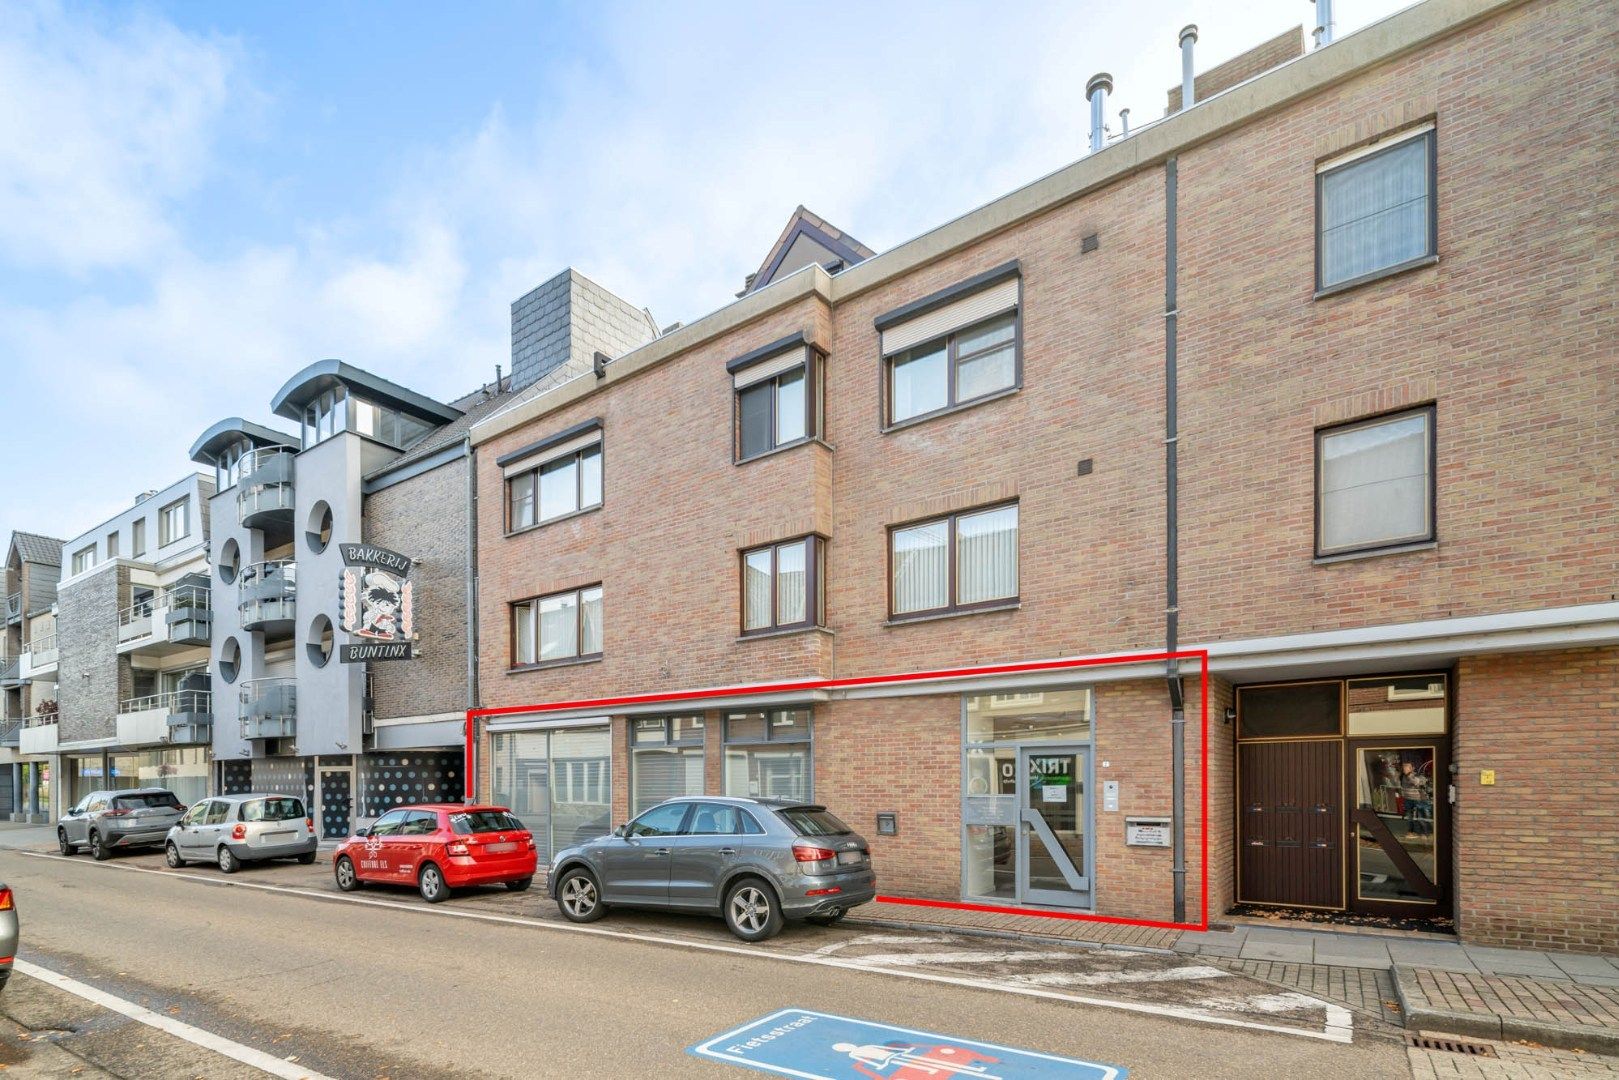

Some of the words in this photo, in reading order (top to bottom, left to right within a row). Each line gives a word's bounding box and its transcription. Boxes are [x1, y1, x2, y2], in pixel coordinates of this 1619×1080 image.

[348, 547, 408, 571] BAKKERIJ
[349, 644, 407, 660] BUNTINX
[726, 1015, 819, 1055] Fietsstraat
